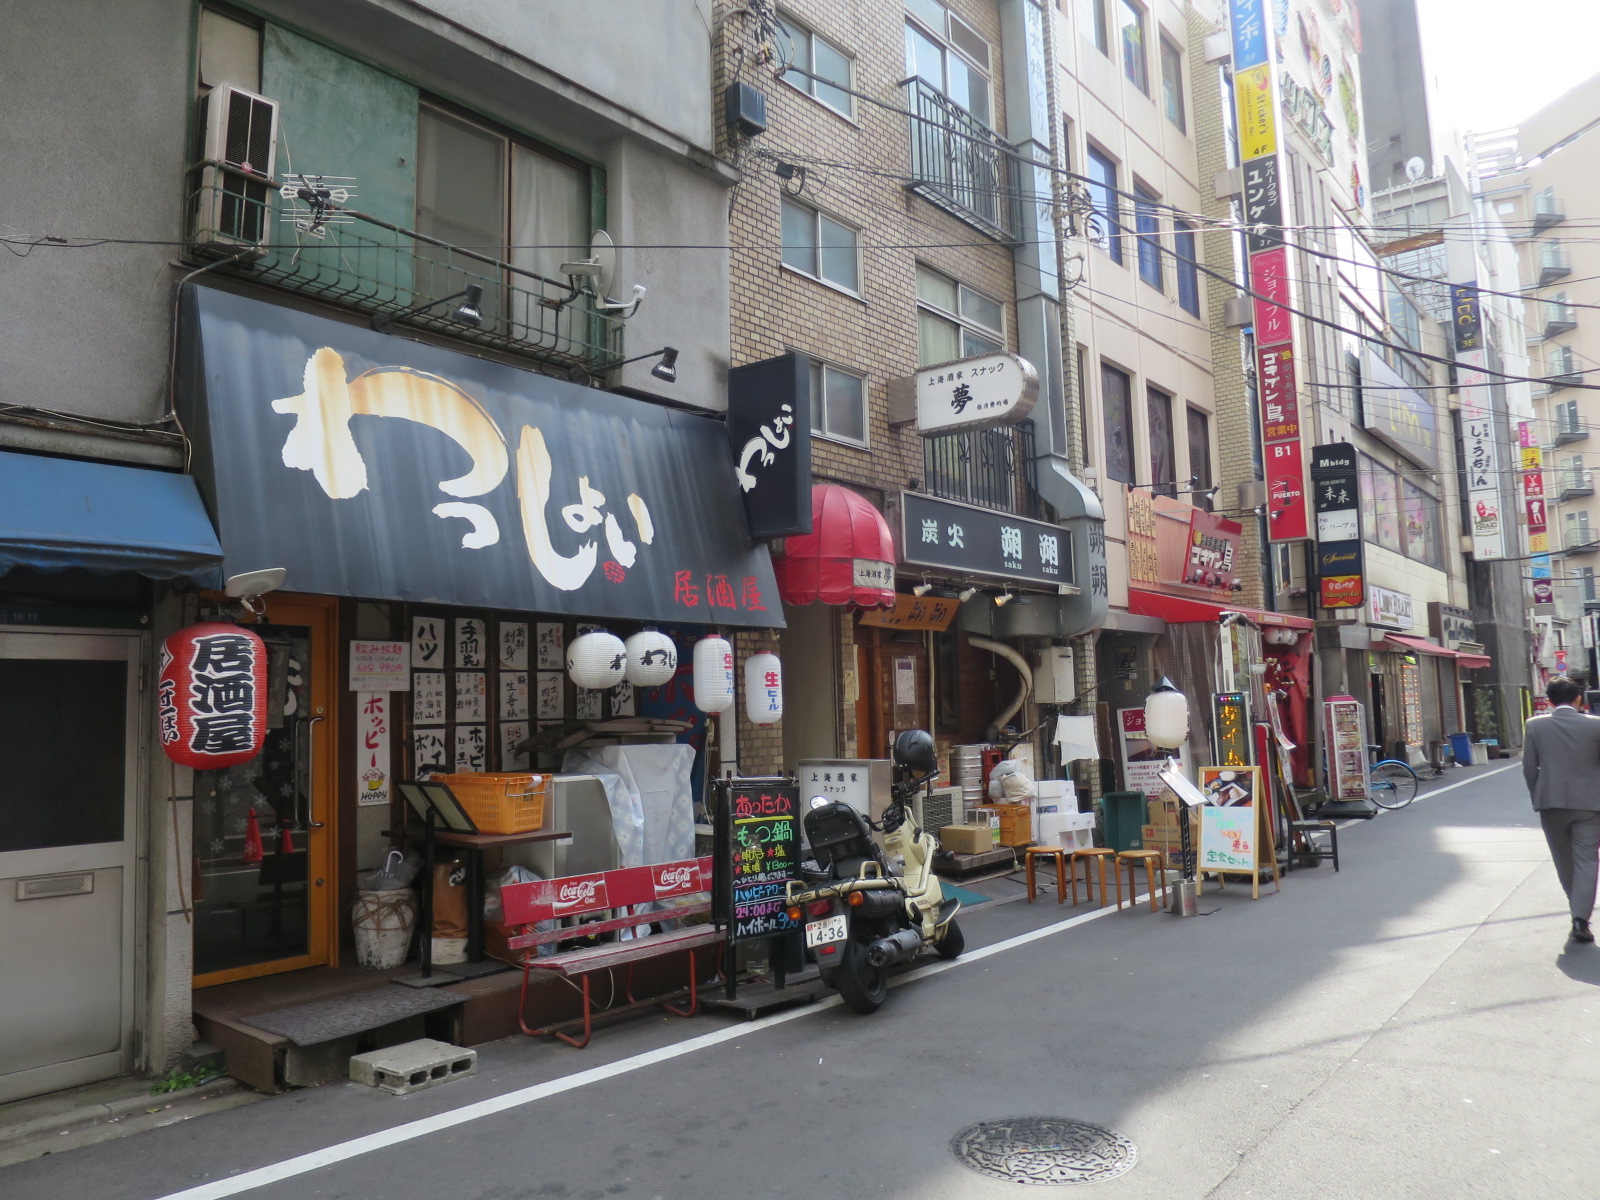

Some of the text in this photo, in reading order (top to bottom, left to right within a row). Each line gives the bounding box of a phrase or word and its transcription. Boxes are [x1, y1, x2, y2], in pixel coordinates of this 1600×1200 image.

[1254, 145, 1267, 155] 4F
[1264, 266, 1281, 332] ジョイフル
[928, 362, 1004, 386] 上海酒家 スナック
[950, 383, 973, 415] 夢
[1263, 352, 1284, 423] ゴキゲン鳥
[1267, 424, 1297, 437] 営業中
[735, 404, 793, 493] わっしょい
[1275, 445, 1291, 457] B1
[271, 346, 654, 591] わっしょい
[1273, 491, 1300, 499] PUERTO
[1325, 486, 1350, 503] 未来
[921, 519, 964, 549] 炭火
[859, 566, 891, 584] 上海酒家 夢
[1004, 560, 1058, 575] saku saku
[674, 570, 768, 611] 居酒屋
[356, 644, 402, 654] 飲み放題
[417, 623, 438, 661] ハツ
[460, 620, 480, 667] 手羽先
[504, 629, 516, 661] 刺身
[357, 663, 402, 672] 60分 990円
[189, 634, 255, 755] 居酒屋
[550, 676, 558, 711] アスパラ
[764, 671, 780, 711] 生ビール
[425, 690, 435, 719] 八海山
[363, 692, 386, 768] ホッピー
[811, 773, 858, 783] 上海酒家
[360, 790, 388, 801] HOPPY
[736, 793, 791, 817] あったか
[737, 821, 793, 847] もつ鍋
[742, 844, 786, 861] 明太子 塩
[1207, 849, 1248, 865] 定食セット
[660, 867, 691, 884] Coca-Cola
[560, 881, 595, 899] Coca-Cola
[736, 901, 782, 918] 24:00まで
[737, 916, 778, 936] ハイボール
